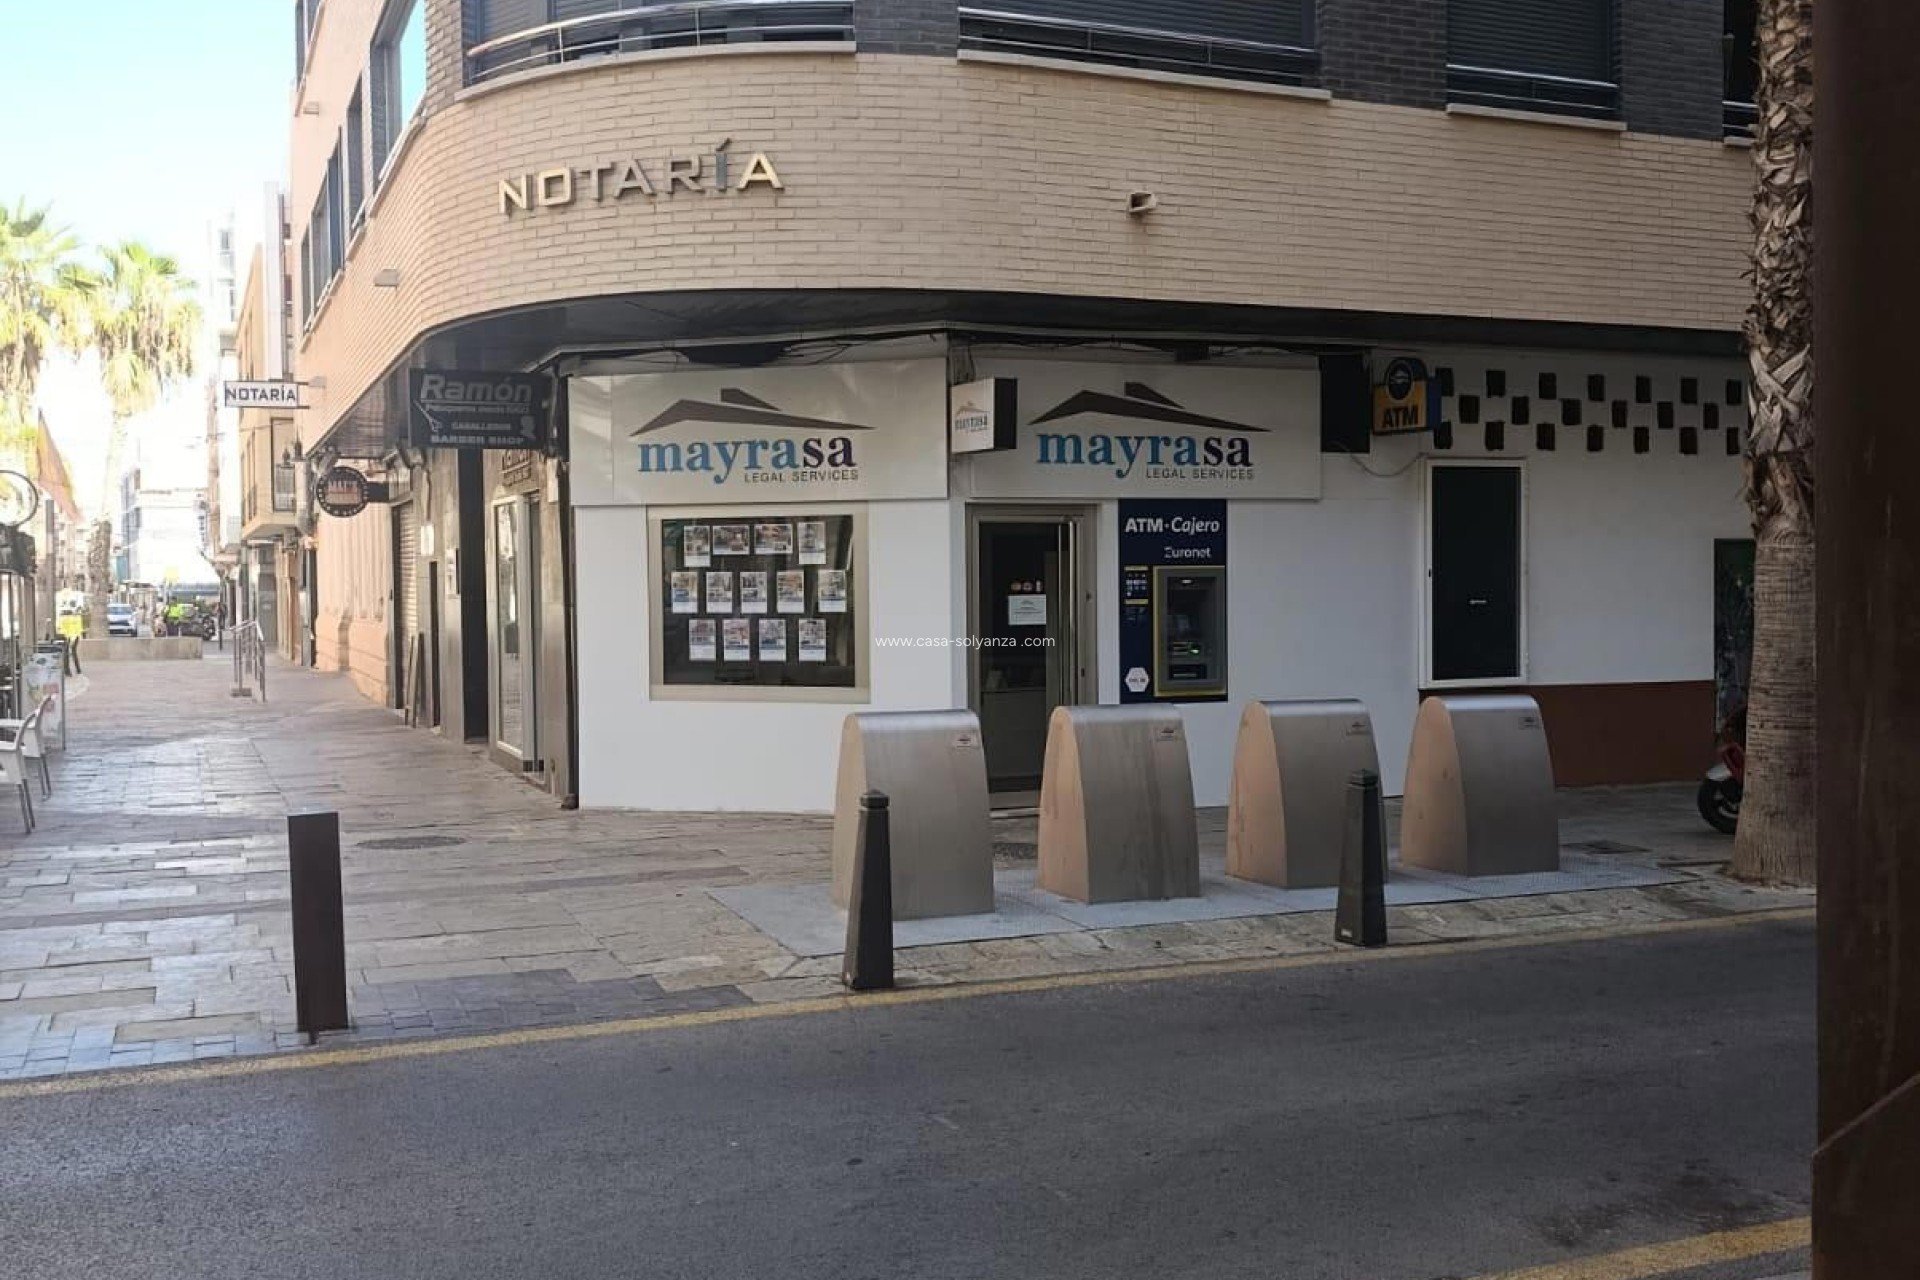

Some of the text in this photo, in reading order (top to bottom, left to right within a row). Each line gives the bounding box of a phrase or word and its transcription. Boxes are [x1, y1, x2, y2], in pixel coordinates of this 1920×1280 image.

[498, 138, 784, 216] NOTARÍA
[225, 384, 296, 402] NOTARÍA
[420, 373, 532, 402] Ramón
[1382, 404, 1419, 428] ATM
[637, 435, 857, 484] mayrasa
[1036, 434, 1253, 479] mayrasa
[744, 469, 859, 483] LEGAL SERVICES
[1146, 468, 1254, 480] LEGAL SERVICES
[1163, 546, 1212, 559] Euronet
